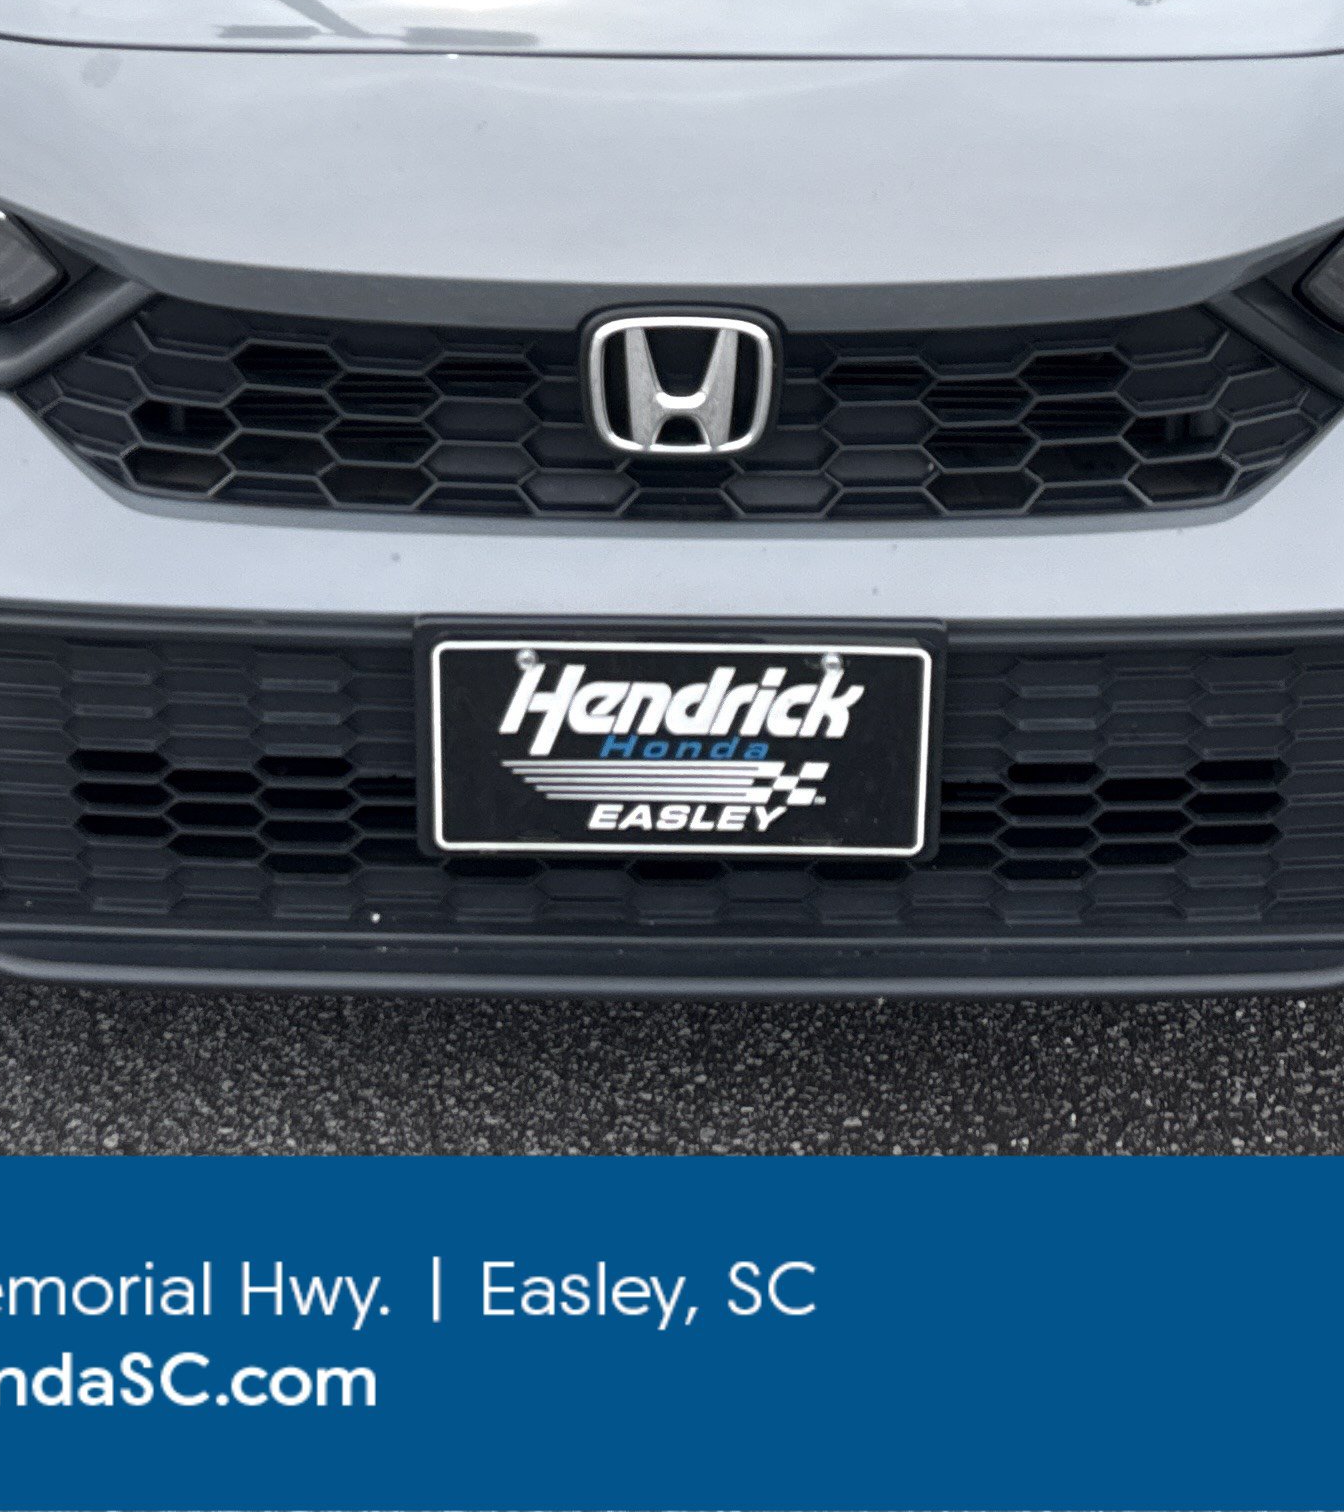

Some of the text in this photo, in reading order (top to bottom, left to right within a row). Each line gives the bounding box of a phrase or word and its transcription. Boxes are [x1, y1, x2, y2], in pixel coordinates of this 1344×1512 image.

[498, 664, 866, 756] Hendrick
[599, 735, 770, 760] Honda
[587, 803, 788, 832] EASLEY
